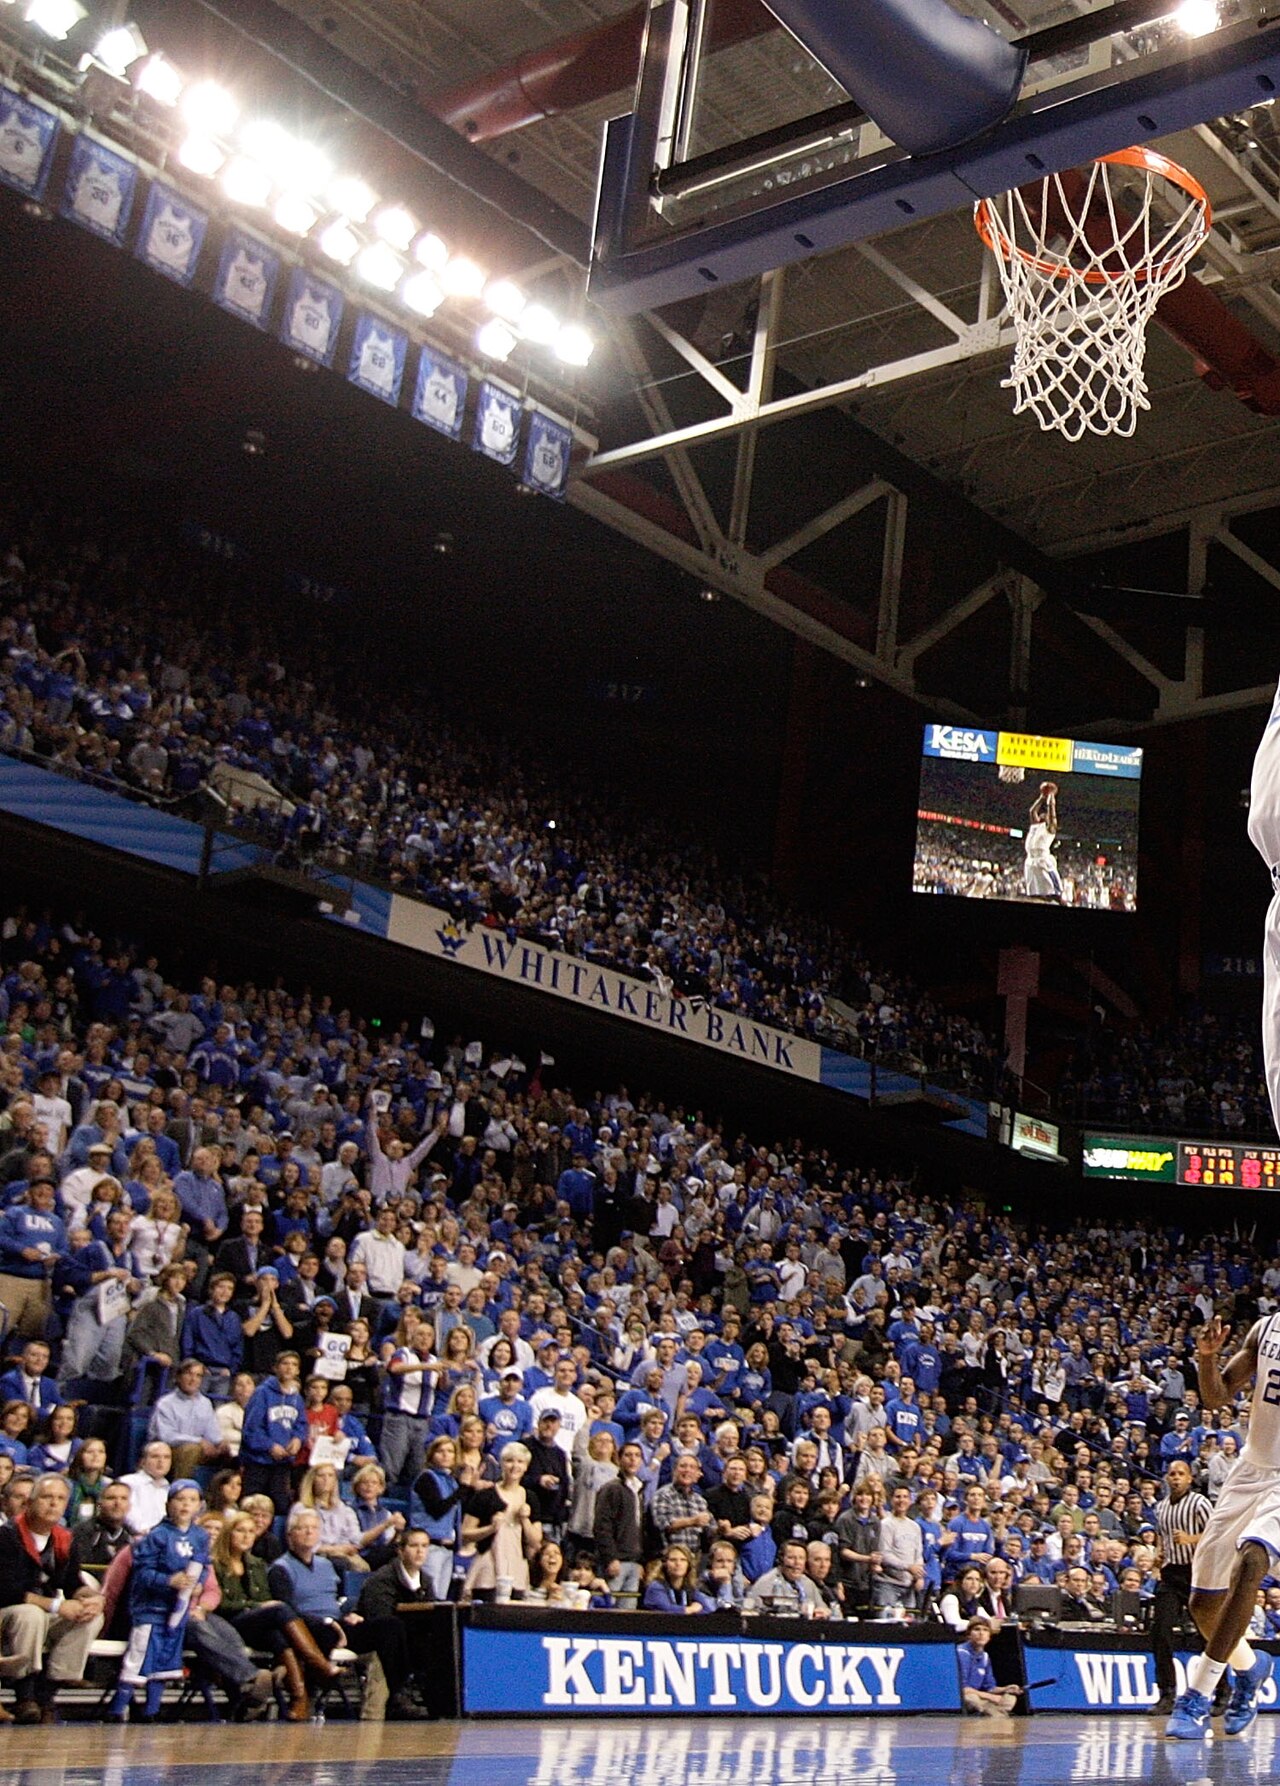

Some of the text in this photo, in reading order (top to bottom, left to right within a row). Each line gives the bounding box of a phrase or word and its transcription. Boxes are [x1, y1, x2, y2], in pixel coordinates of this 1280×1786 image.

[931, 724, 989, 754] KESA
[1010, 736, 1060, 749] KENTUCKY
[482, 931, 794, 1069] WHITAKER BANK
[1083, 1148, 1173, 1171] SUBWAY
[25, 1214, 55, 1232] UK
[327, 1340, 348, 1353] GO
[542, 1636, 905, 1707] KENTUCKY
